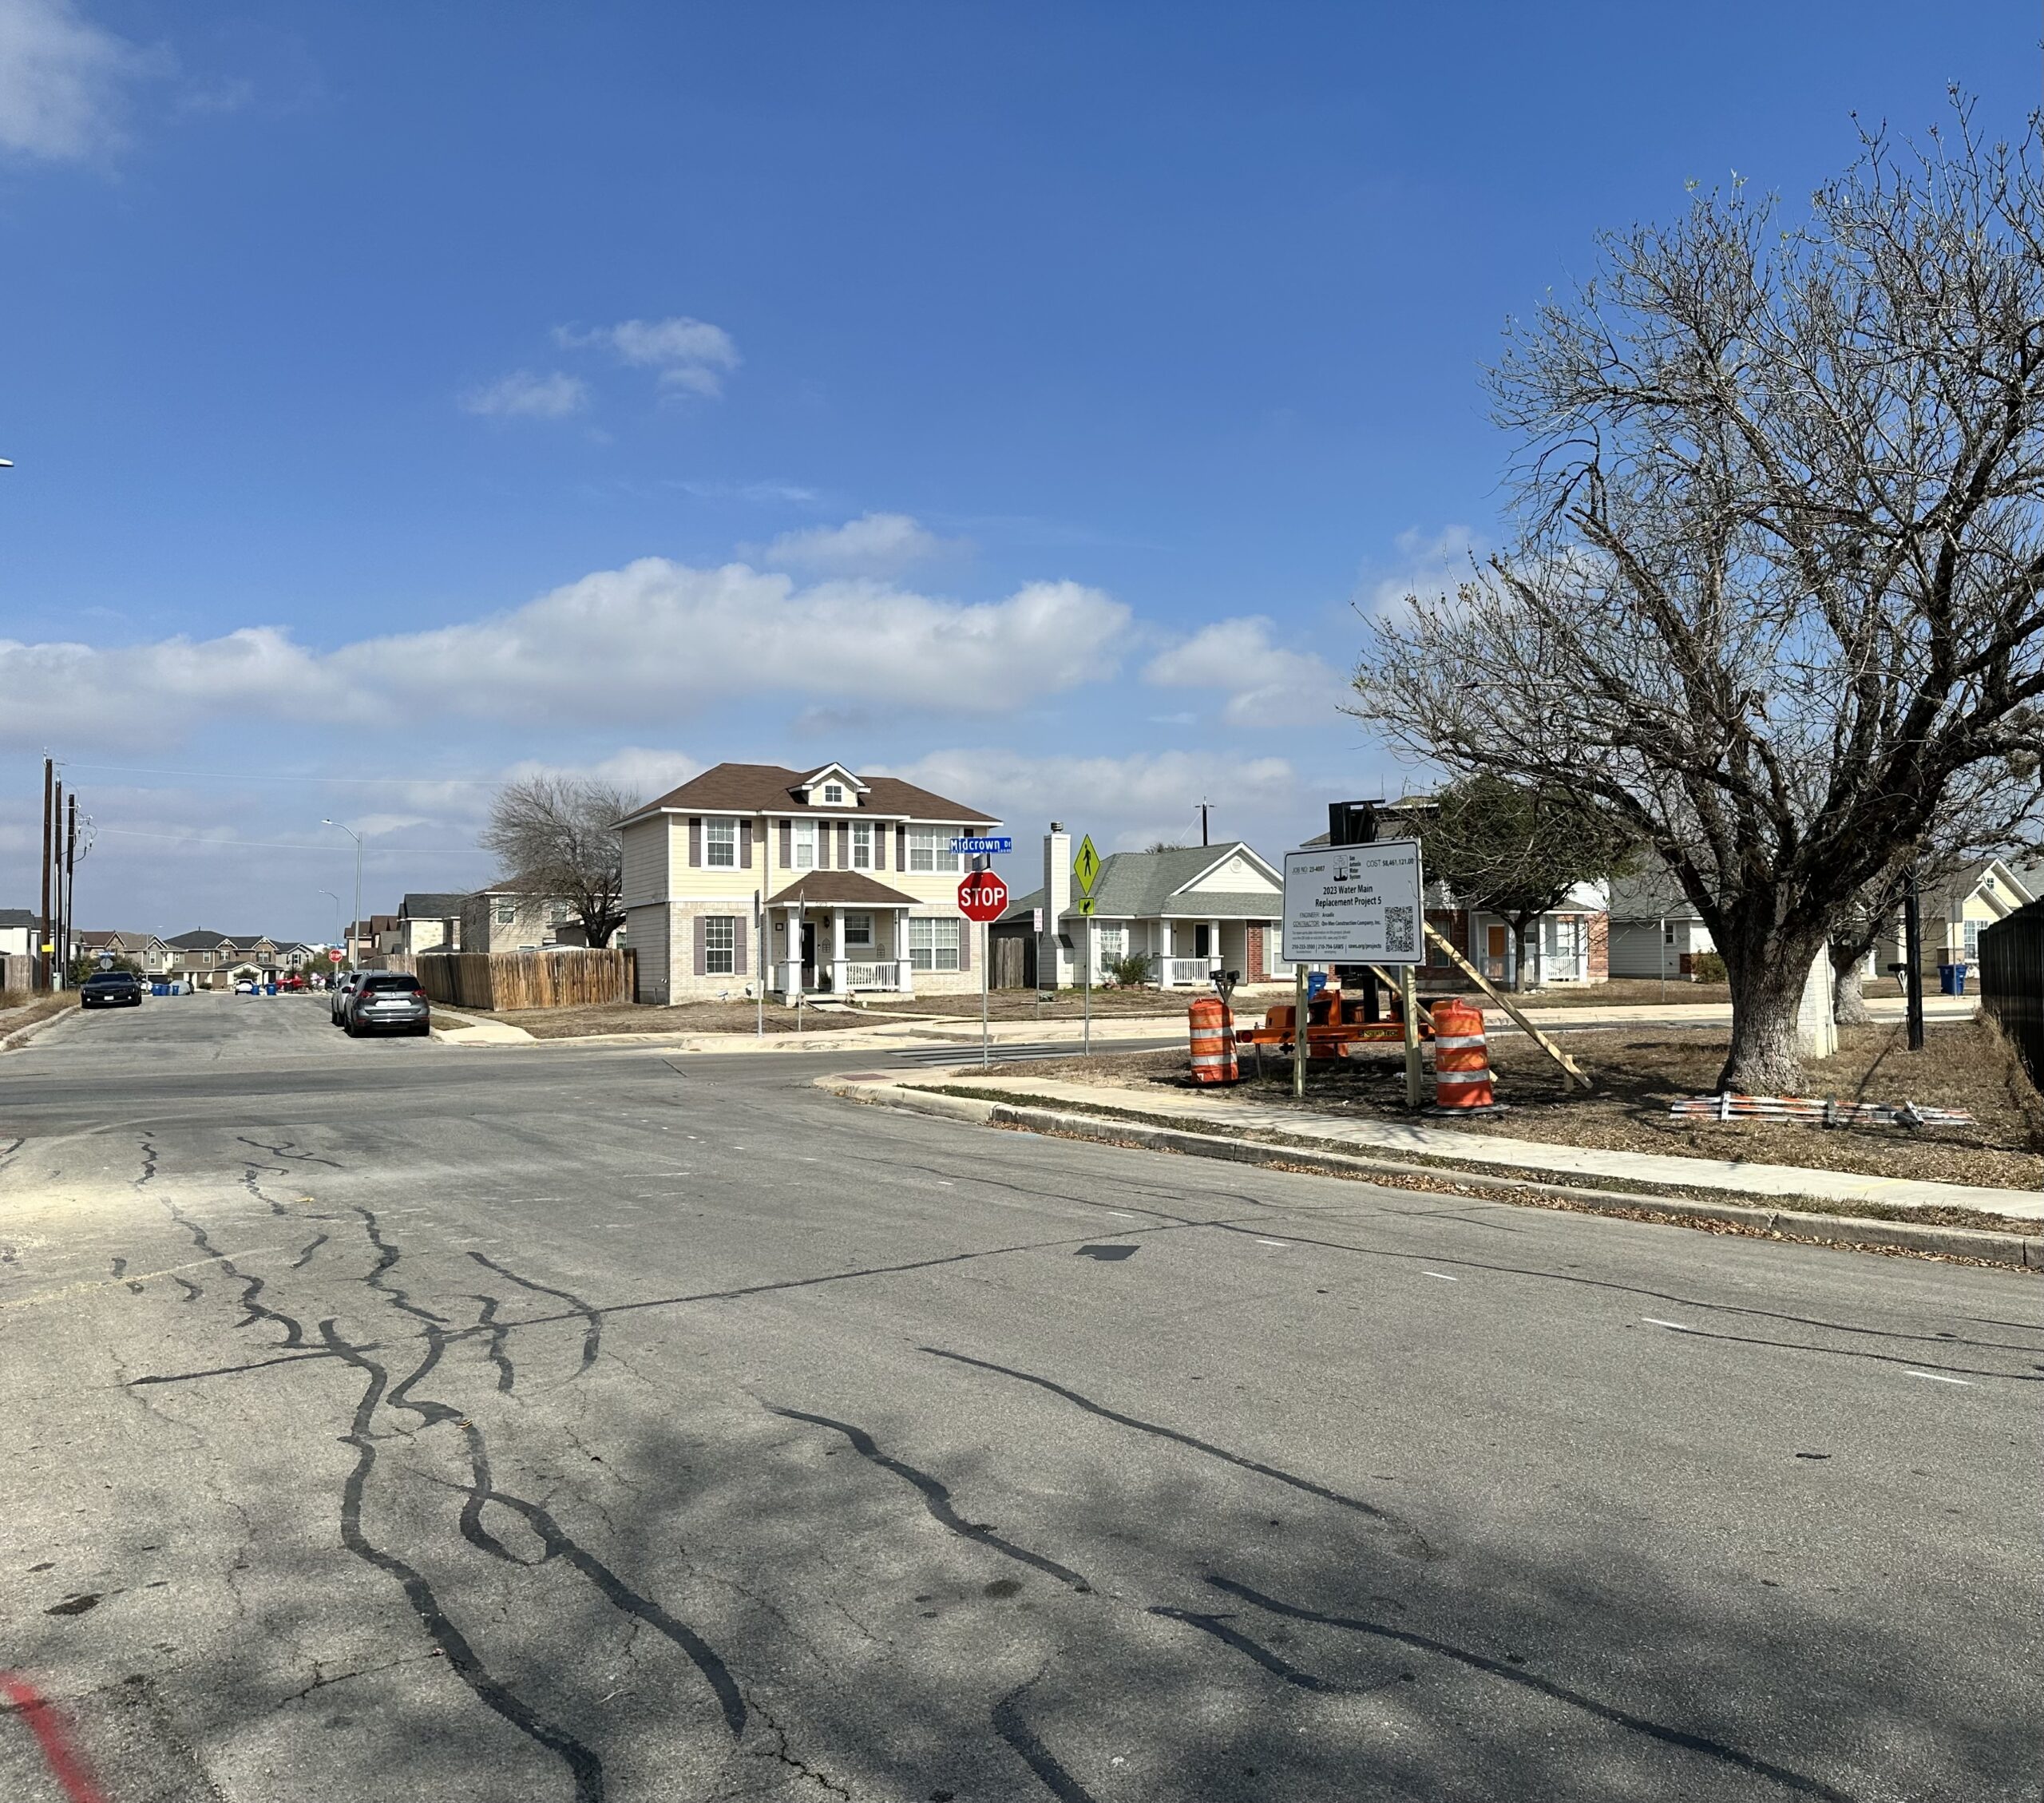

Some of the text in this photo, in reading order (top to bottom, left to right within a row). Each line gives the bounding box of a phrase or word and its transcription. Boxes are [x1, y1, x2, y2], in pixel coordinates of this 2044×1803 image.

[950, 839, 1000, 850] Midcrown
[1323, 884, 1373, 895] 2023 Water Main
[961, 887, 1005, 907] STOP
[1315, 895, 1382, 909] Replacement Project 5
